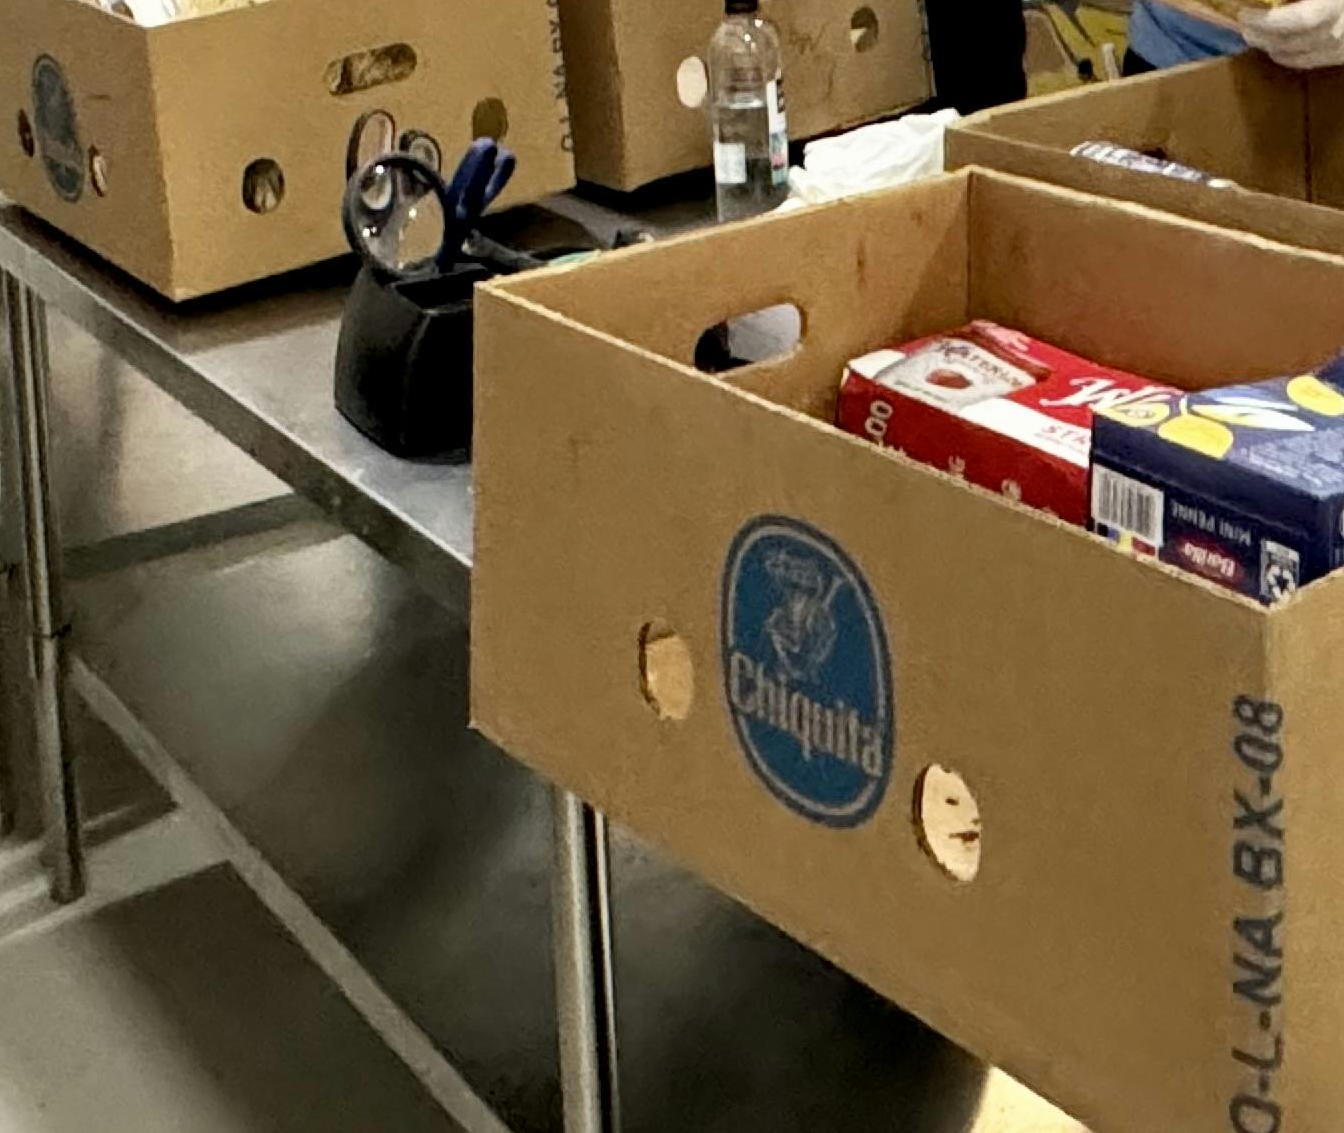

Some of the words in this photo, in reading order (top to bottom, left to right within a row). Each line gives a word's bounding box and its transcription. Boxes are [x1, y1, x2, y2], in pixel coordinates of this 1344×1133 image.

[1170, 499, 1216, 534] PENNE
[1218, 521, 1253, 548] MINI
[1183, 541, 1236, 578] Barilla
[730, 650, 884, 779] Chiquita
[1232, 694, 1284, 890] BX-08
